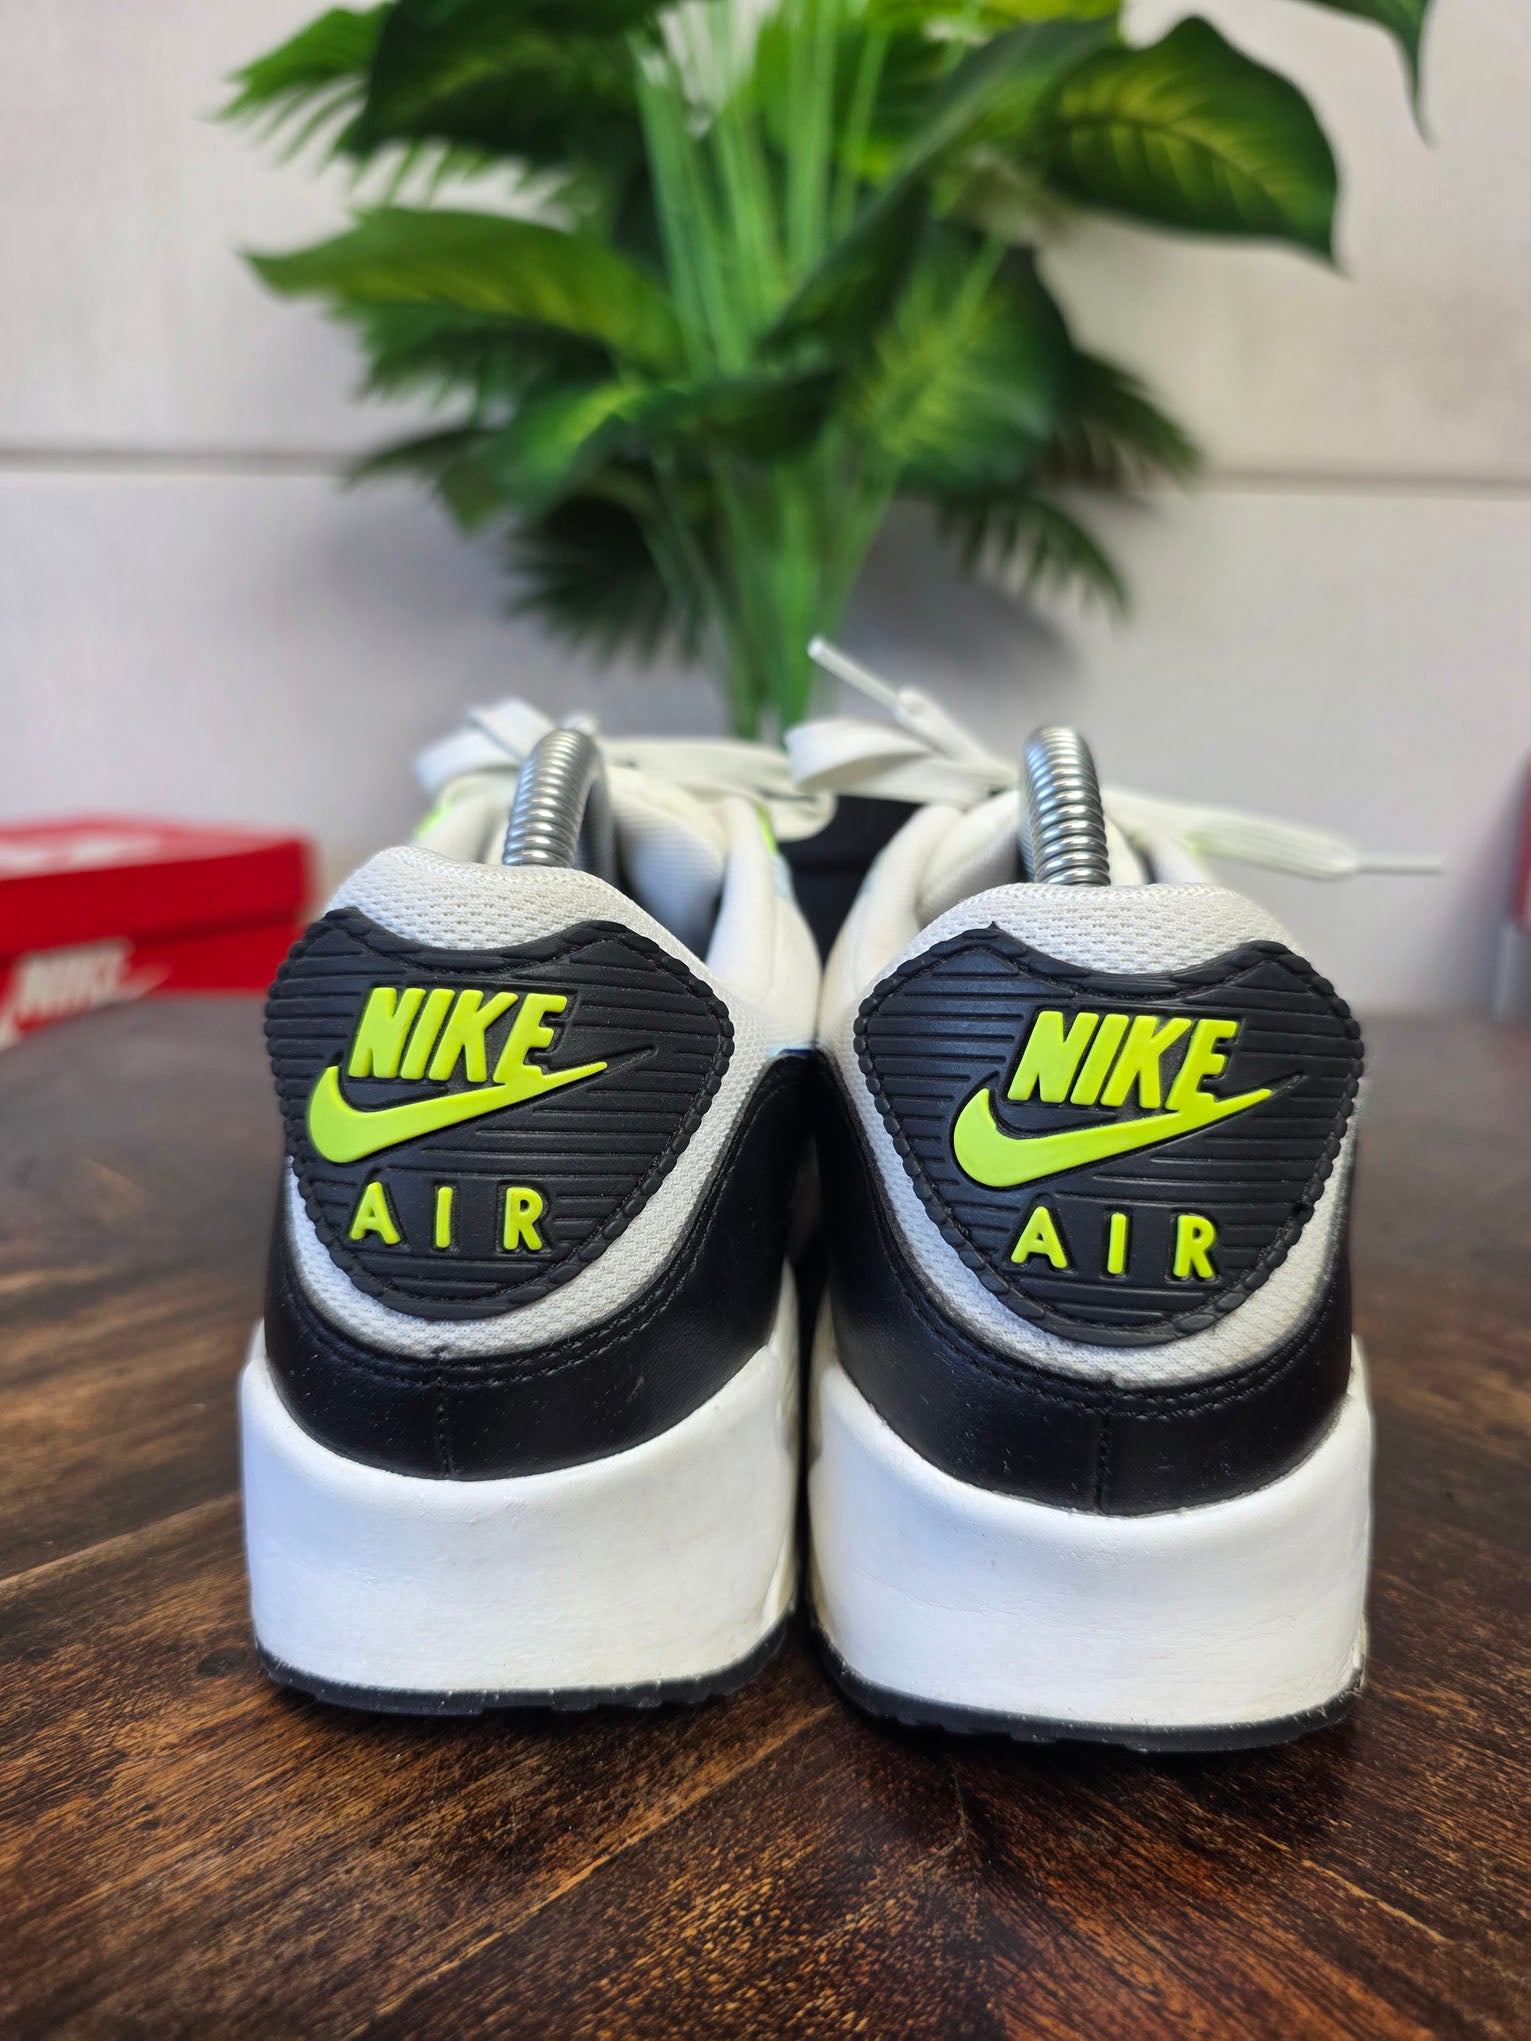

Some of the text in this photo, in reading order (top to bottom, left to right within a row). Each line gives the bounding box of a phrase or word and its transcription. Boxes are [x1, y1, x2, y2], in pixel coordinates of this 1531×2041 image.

[349, 987, 568, 1083] NIKE
[1009, 1011, 1237, 1109] NIKE
[350, 1181, 543, 1250] AIR
[1012, 1207, 1215, 1279] AIR
